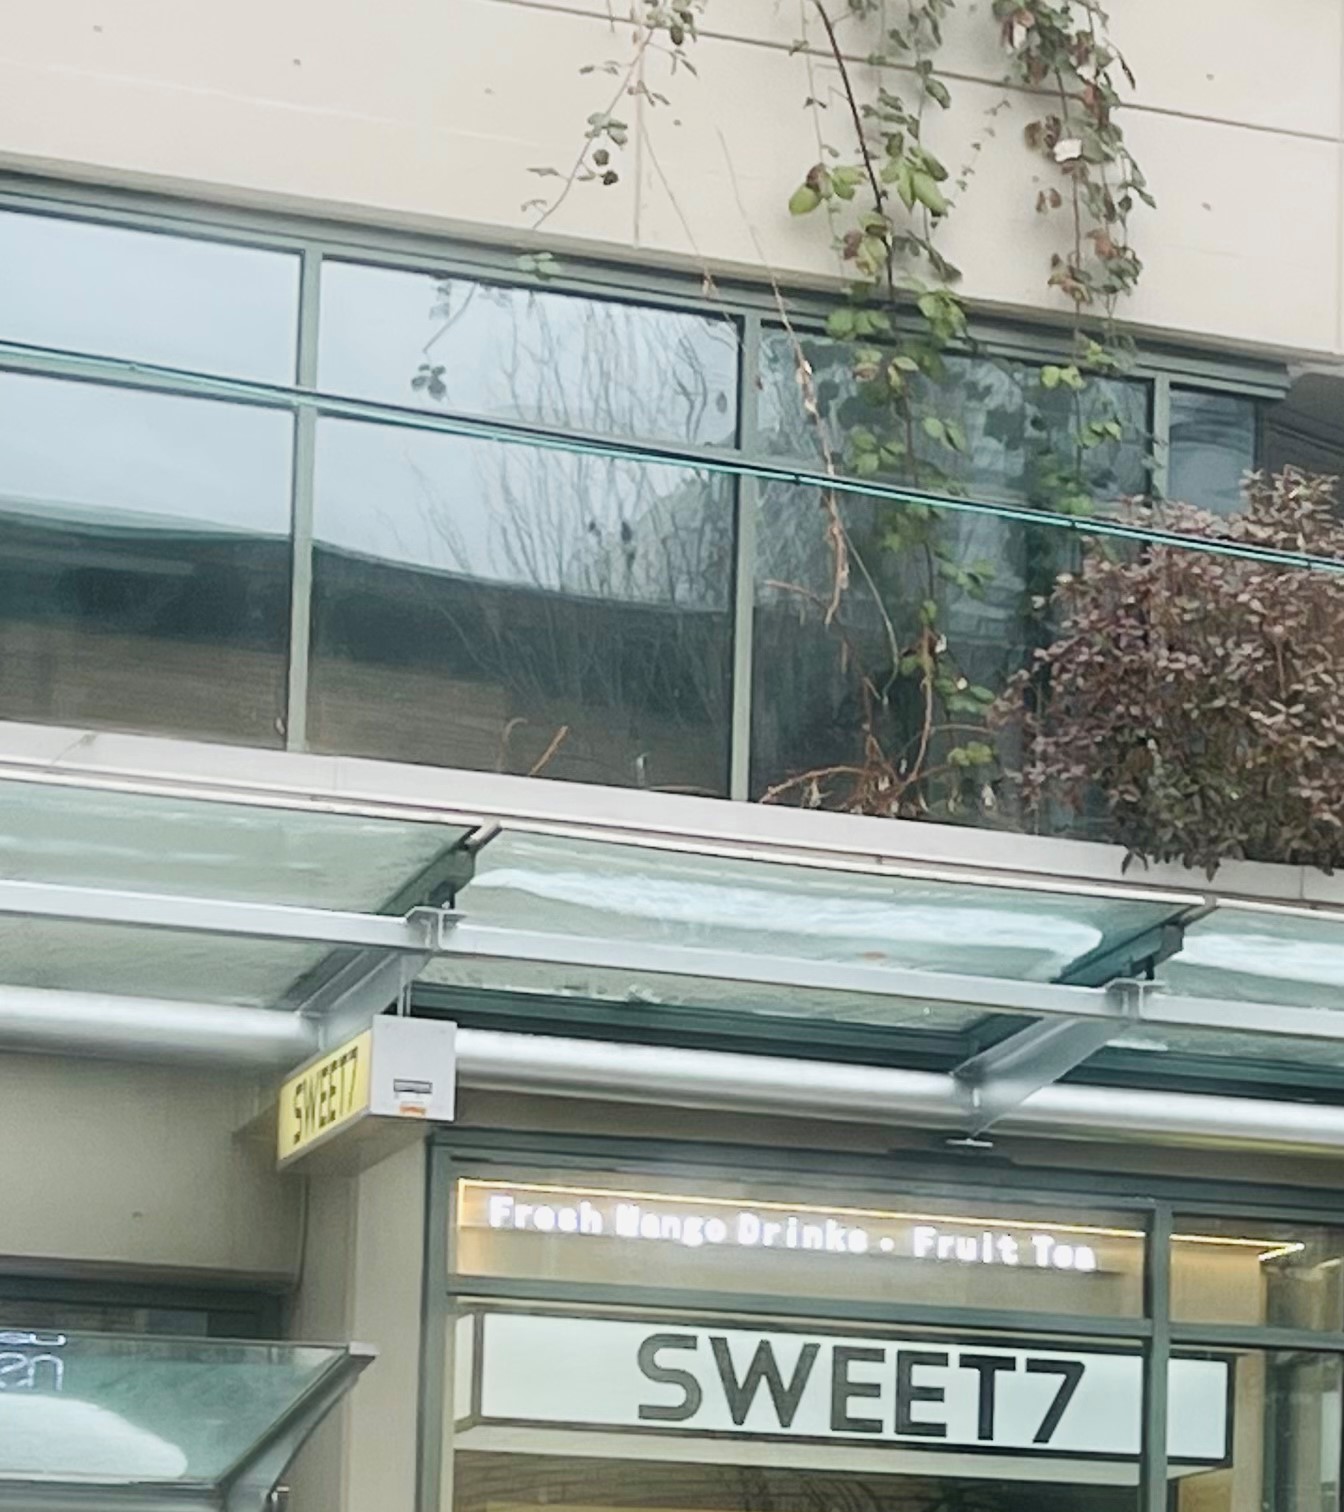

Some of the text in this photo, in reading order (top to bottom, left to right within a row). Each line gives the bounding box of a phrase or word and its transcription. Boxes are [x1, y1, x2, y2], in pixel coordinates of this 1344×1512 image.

[293, 1046, 358, 1145] SWEET7
[489, 1195, 1096, 1272] Fresh Mango Drinks Fruit Tea
[637, 1333, 1086, 1444] SWEET7
